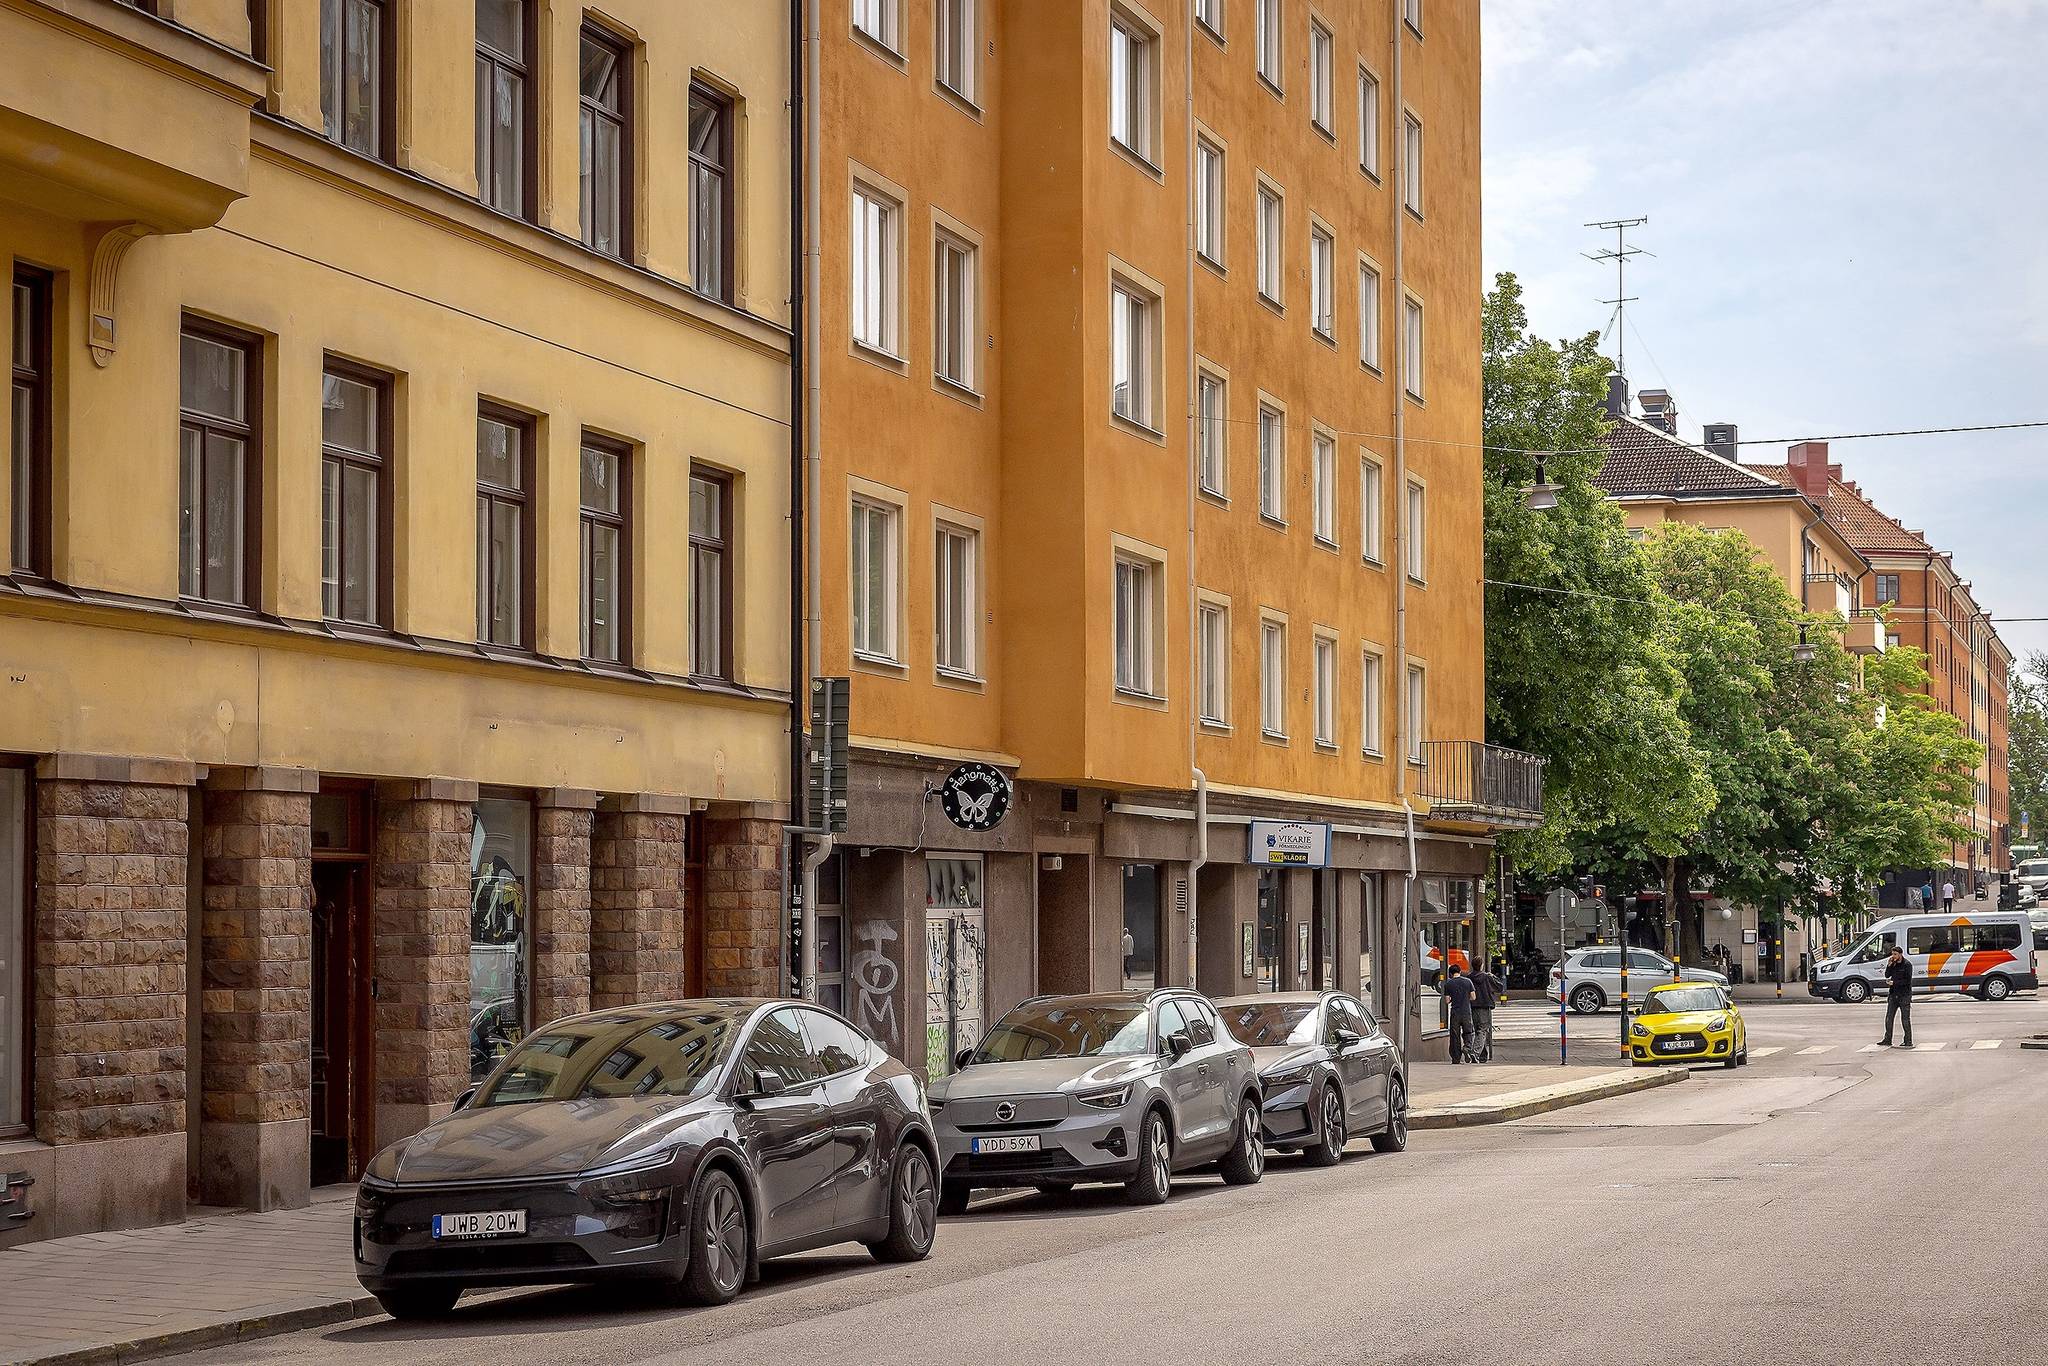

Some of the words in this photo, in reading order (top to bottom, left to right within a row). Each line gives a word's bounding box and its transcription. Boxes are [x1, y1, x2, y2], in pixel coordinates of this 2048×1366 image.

[951, 771, 1000, 793] Hangmatta
[1278, 835, 1312, 844] VIKARIE
[983, 1139, 1006, 1152] YDD
[1010, 1137, 1034, 1150] 59K
[448, 1215, 479, 1233] JWB
[485, 1213, 518, 1231] 20W
